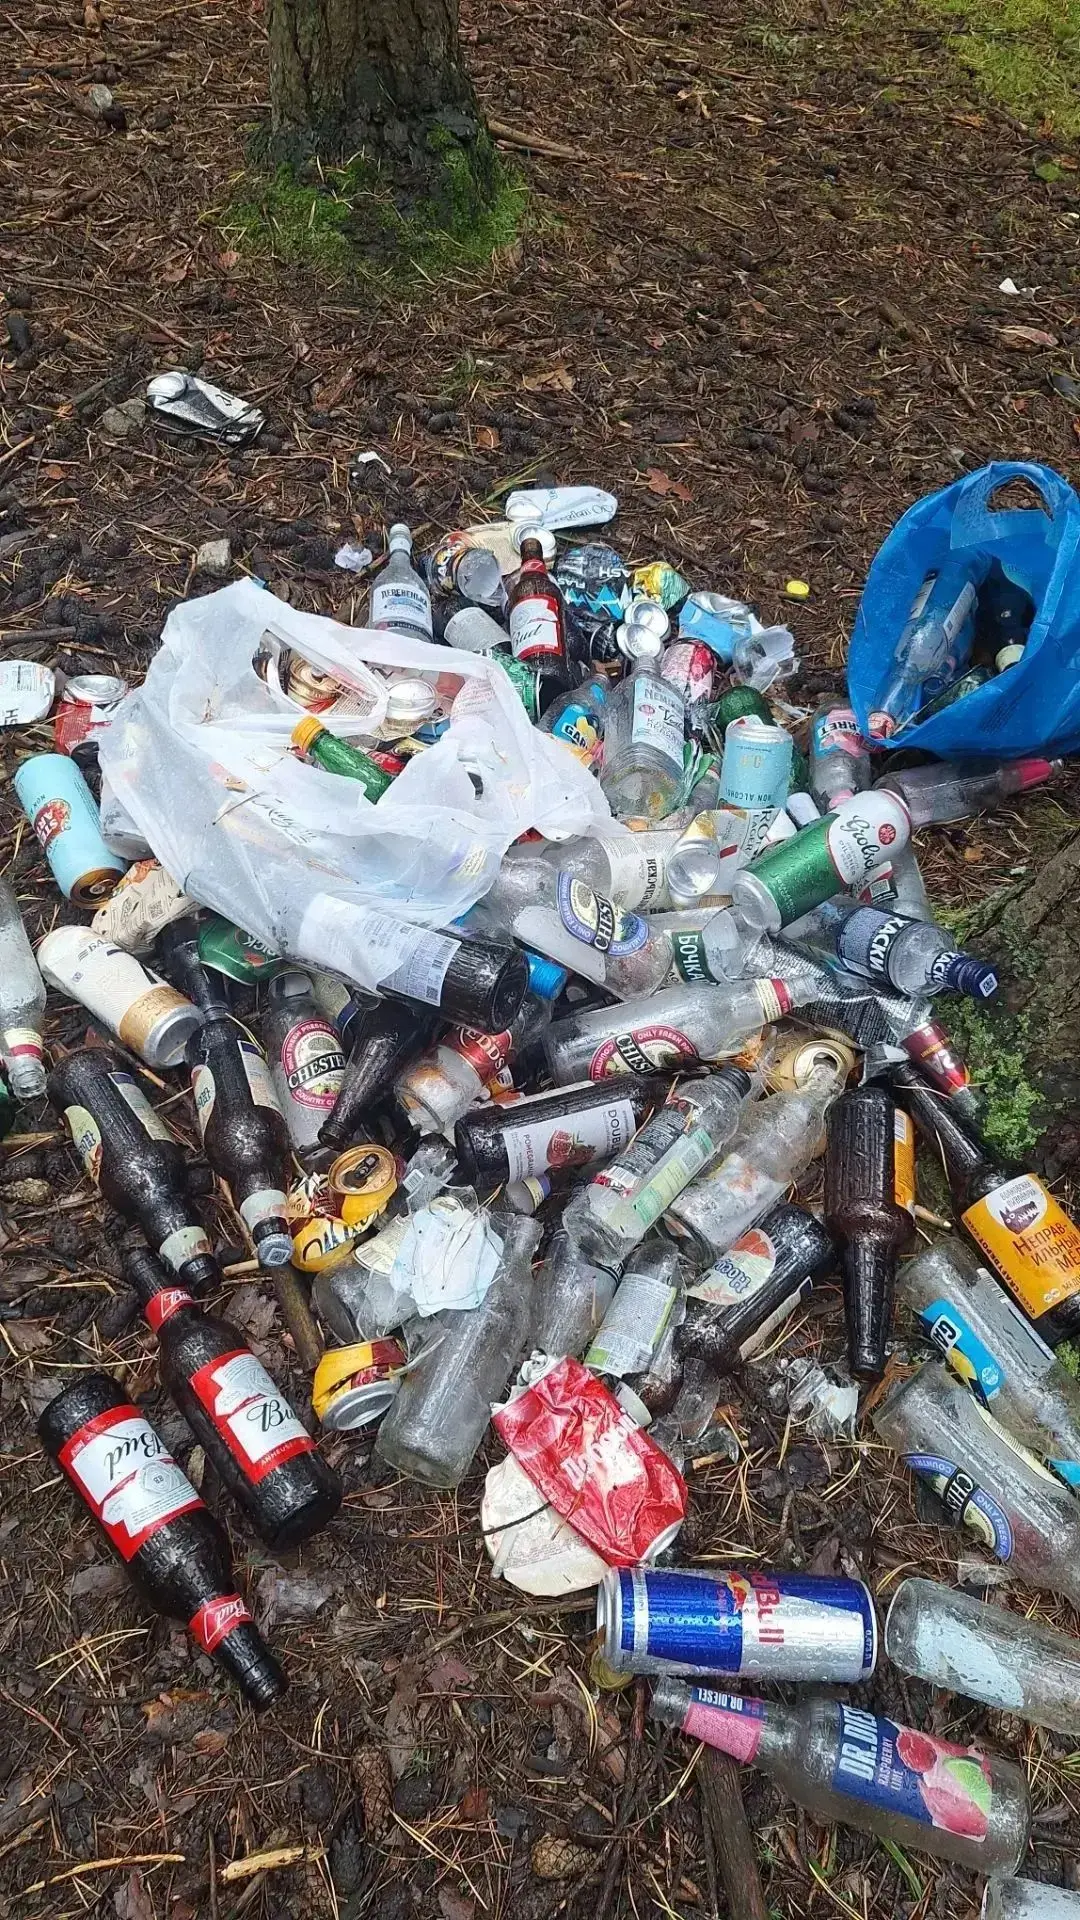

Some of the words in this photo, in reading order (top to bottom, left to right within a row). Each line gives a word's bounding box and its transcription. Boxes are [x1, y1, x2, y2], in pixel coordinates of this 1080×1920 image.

[556, 577, 586, 589] FLAS
[599, 565, 632, 578] ASH
[821, 720, 858, 736] RRET
[868, 917, 911, 972] ХАСКИ
[637, 1030, 658, 1041] ONLY
[658, 1029, 683, 1045] FRESH
[616, 1034, 653, 1074] CHES
[288, 1054, 345, 1090] CHESTE
[165, 1289, 192, 1305] Bu
[931, 1320, 957, 1350] GA
[104, 1429, 166, 1482] Bud
[976, 1494, 999, 1518] ONLY
[214, 1597, 252, 1629] Bud
[697, 1687, 743, 1713] DR.DIESEL
[877, 1736, 894, 1789] RASPBERRY
[891, 1767, 904, 1793] LIME
